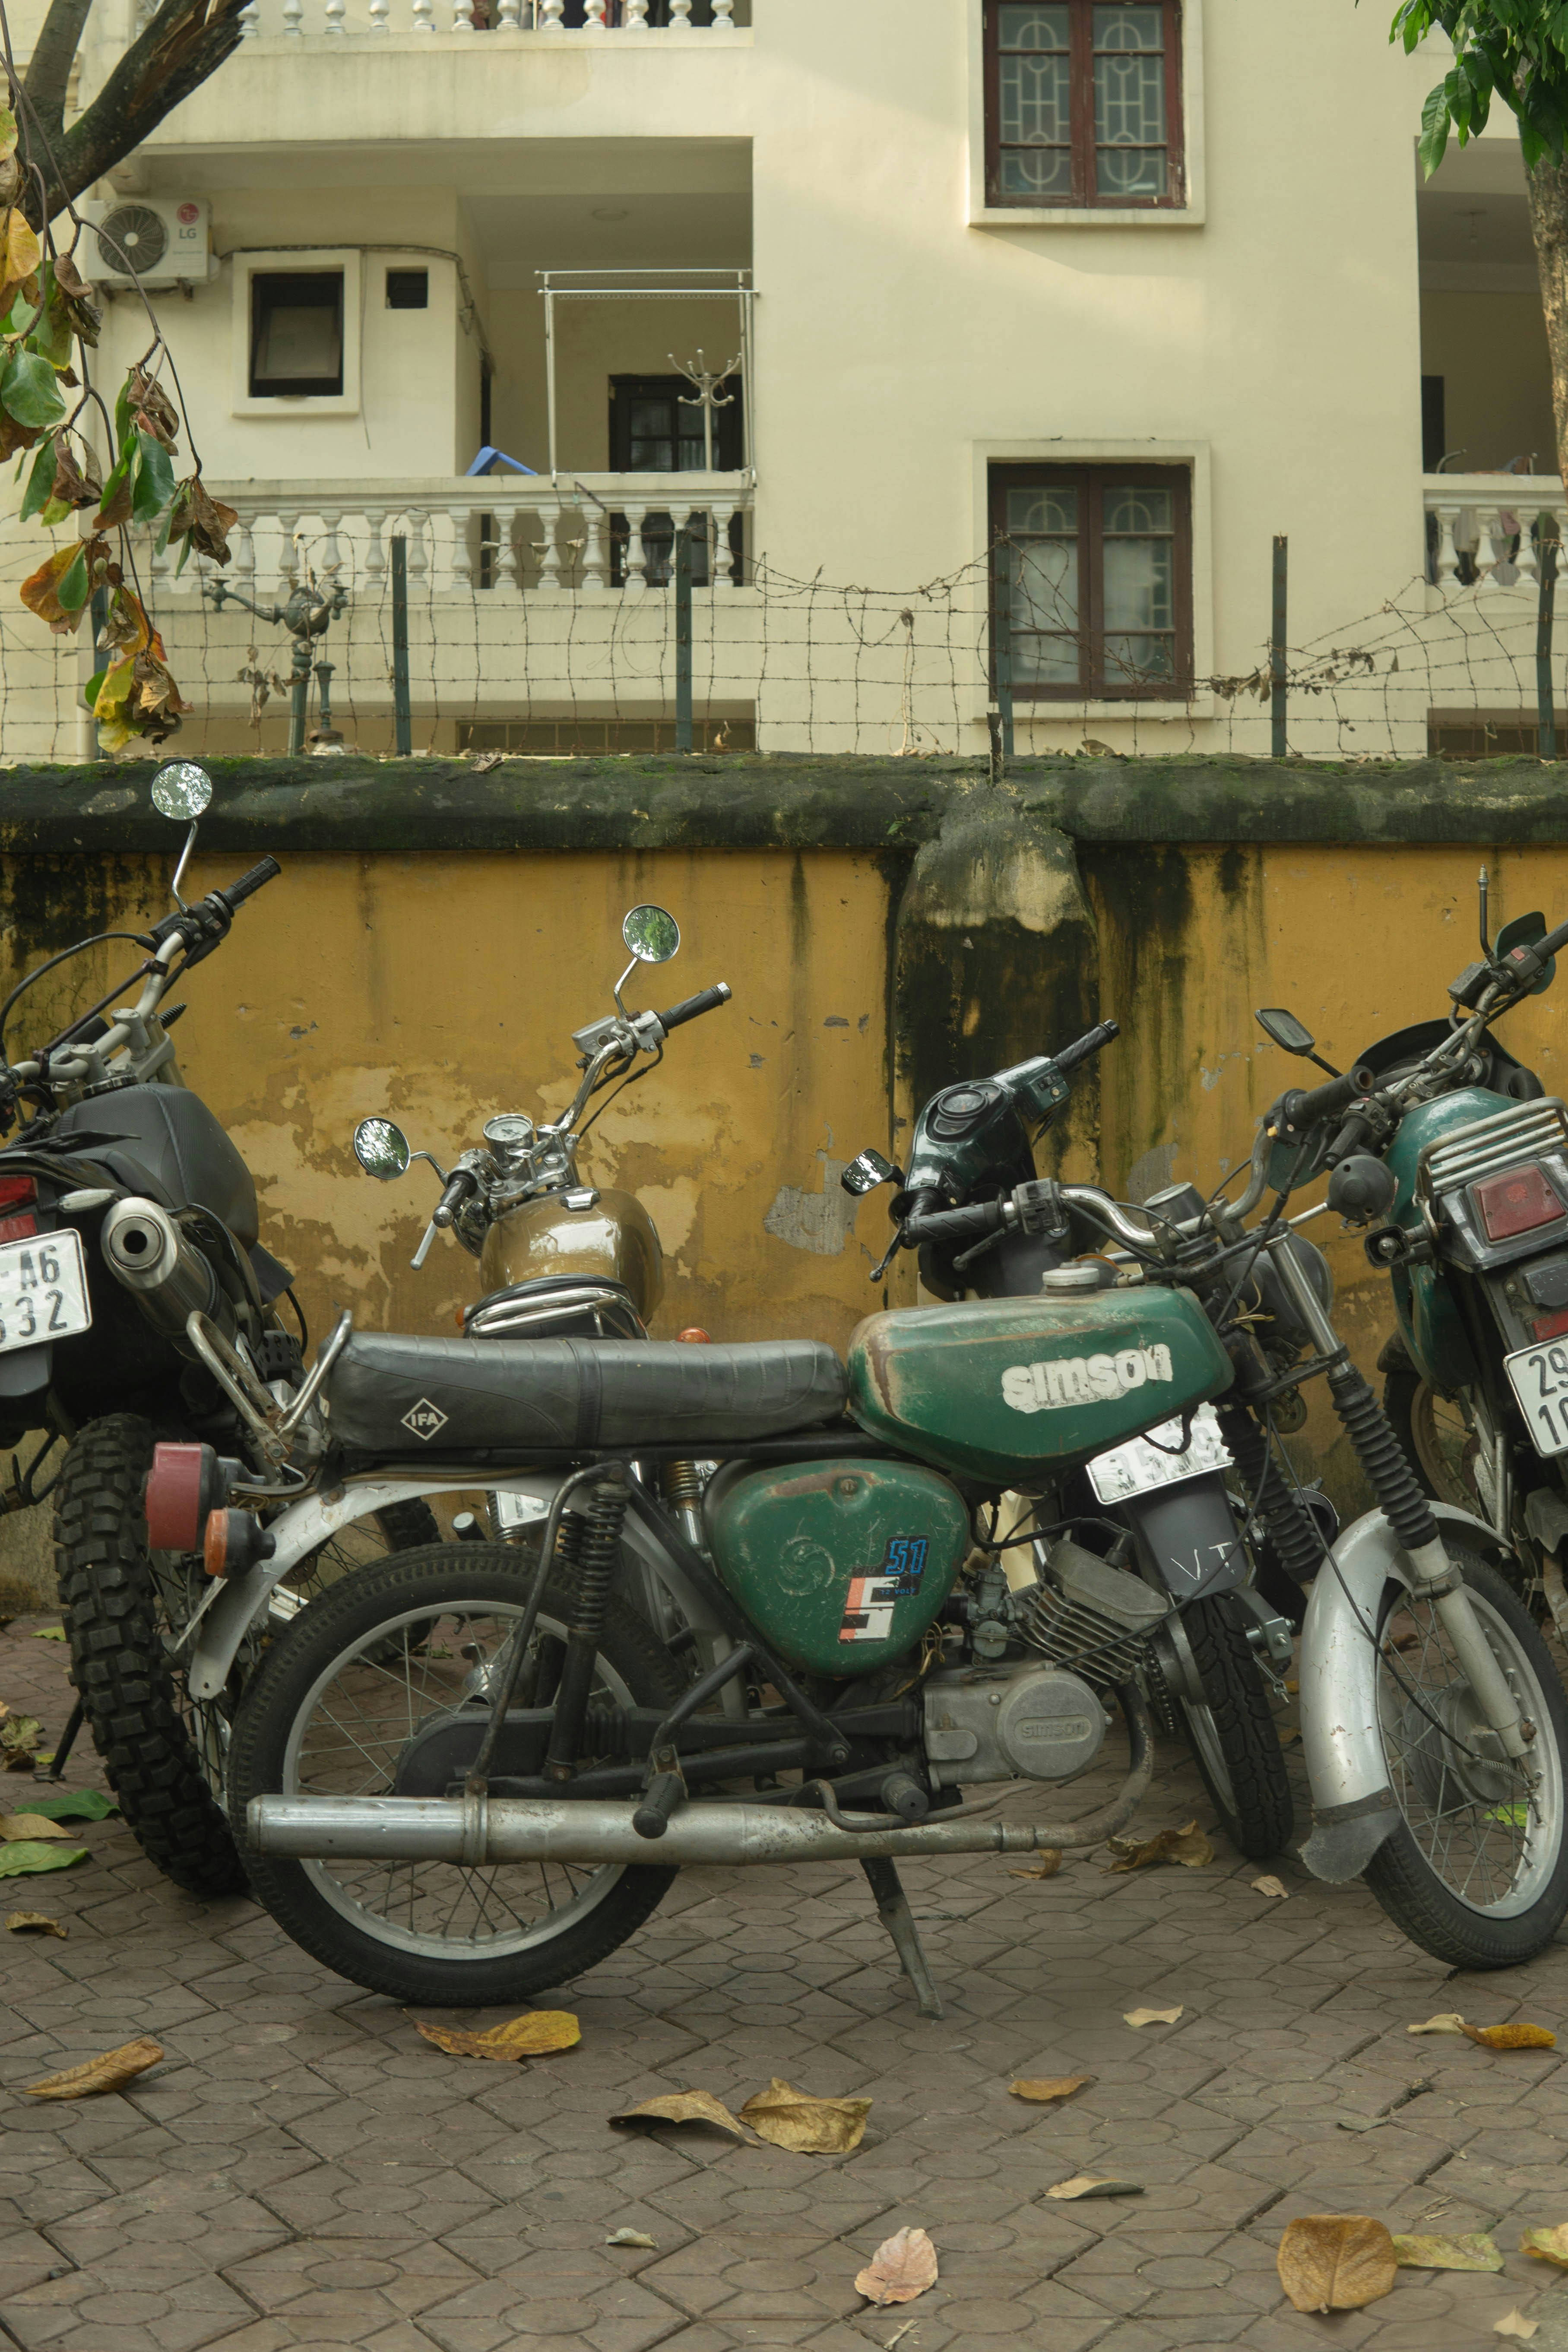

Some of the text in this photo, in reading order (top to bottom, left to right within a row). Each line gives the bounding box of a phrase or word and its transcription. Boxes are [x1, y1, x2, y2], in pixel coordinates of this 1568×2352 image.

[179, 228, 196, 239] LG
[0, 1289, 67, 1344] 32
[411, 1412, 439, 1427] IFA
[885, 1540, 926, 1574] 51
